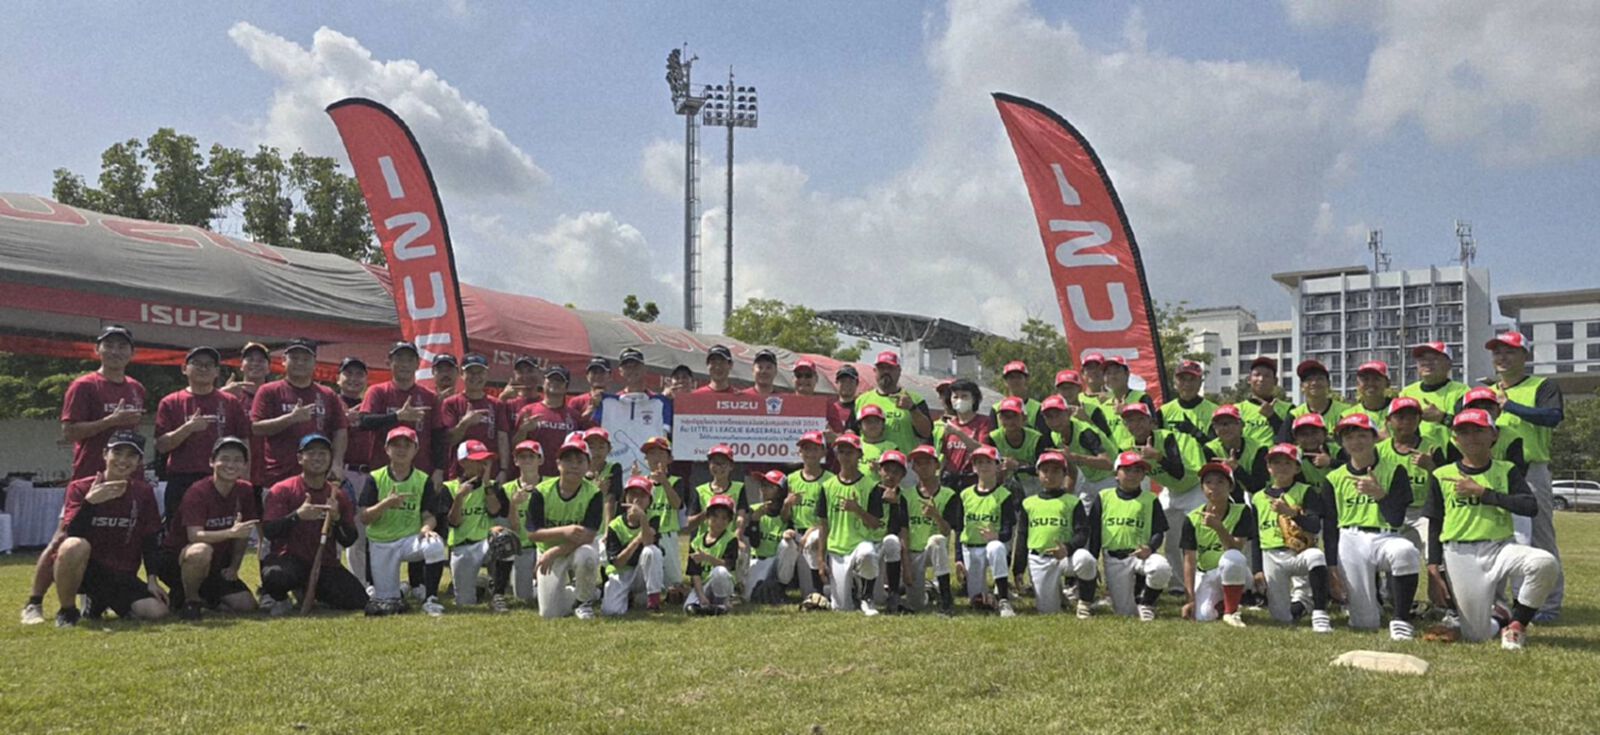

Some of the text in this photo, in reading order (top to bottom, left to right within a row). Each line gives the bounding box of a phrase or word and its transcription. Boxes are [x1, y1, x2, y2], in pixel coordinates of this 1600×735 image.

[141, 303, 242, 332] ISUZU
[716, 400, 759, 410] ISUZU
[720, 443, 788, 459] 00,000
[1451, 496, 1482, 508] ISU
[92, 516, 137, 527] ISUZU
